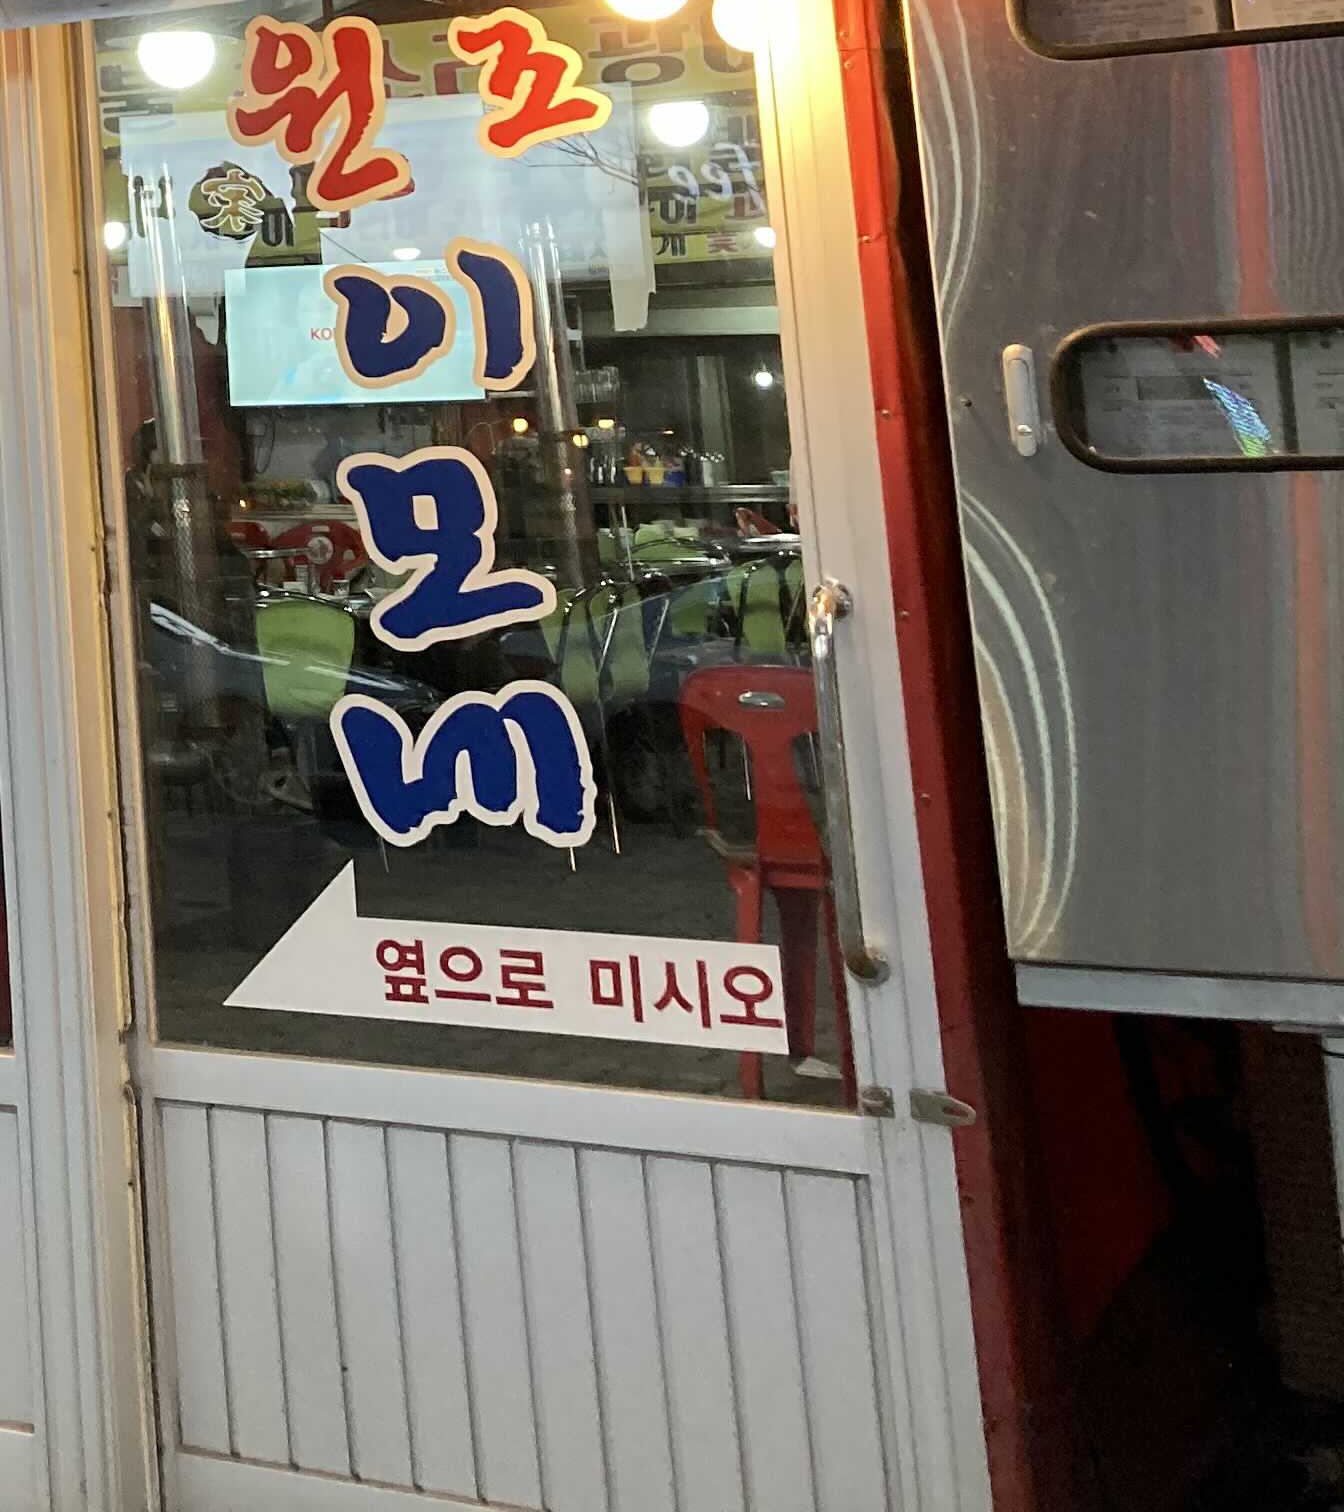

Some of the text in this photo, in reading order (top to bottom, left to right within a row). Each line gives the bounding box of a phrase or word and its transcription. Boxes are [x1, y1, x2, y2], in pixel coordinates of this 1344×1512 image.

[226, 6, 612, 212] 원조
[374, 937, 786, 1031] 옆으로 미시오
